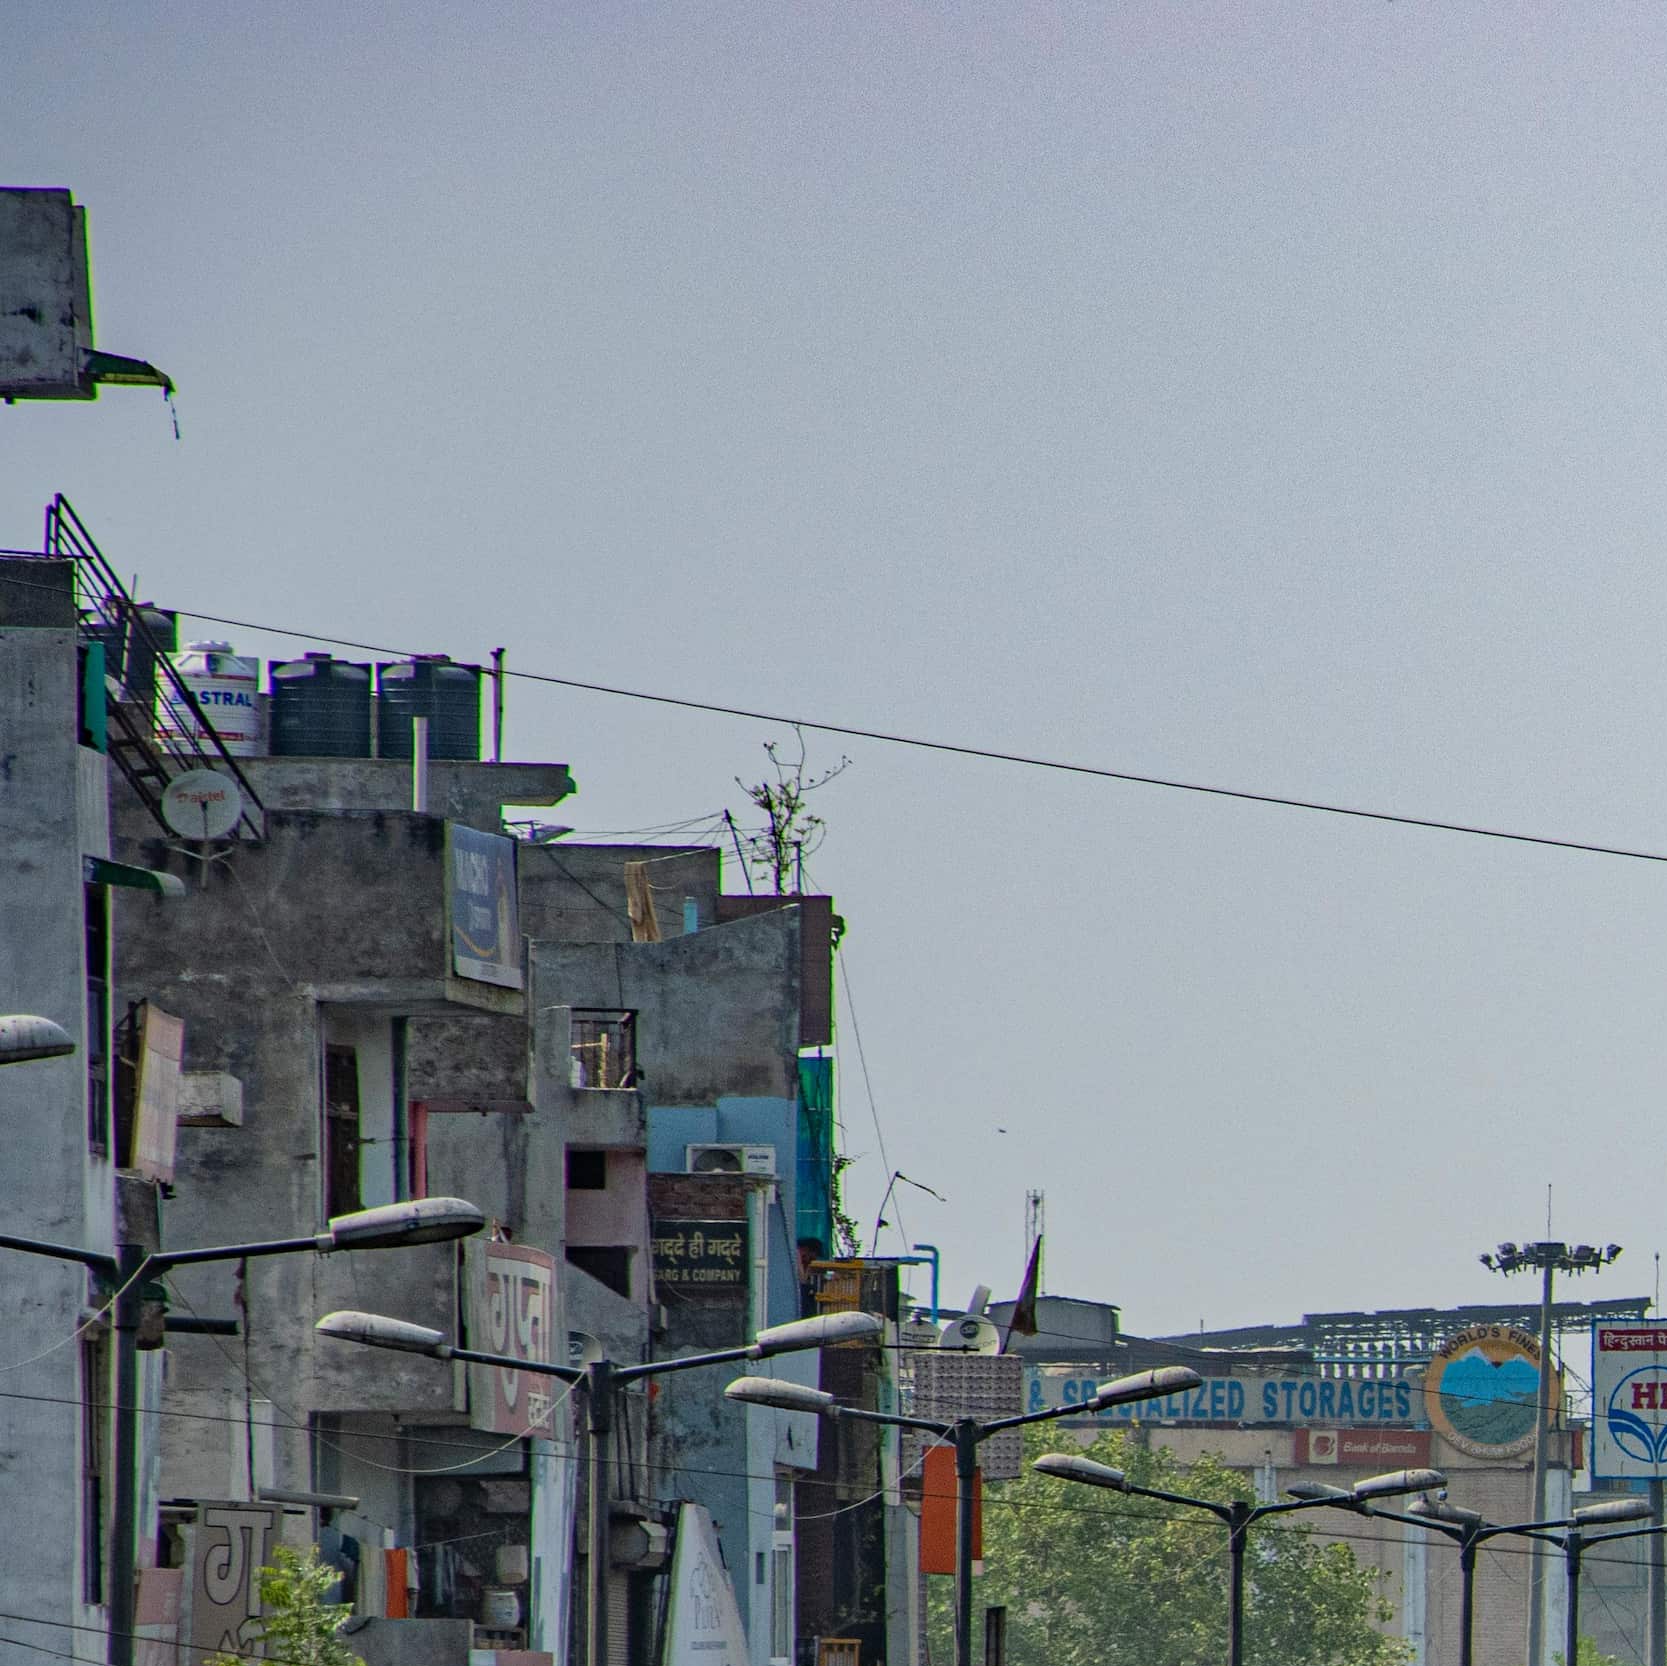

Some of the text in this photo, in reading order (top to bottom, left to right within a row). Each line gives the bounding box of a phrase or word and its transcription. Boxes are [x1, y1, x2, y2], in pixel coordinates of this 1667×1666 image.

[688, 1231, 705, 1259] ही
[707, 1232, 742, 1265] गद्दे
[682, 1269, 741, 1281] & COMPANY
[1440, 1325, 1501, 1360] WORLD'S
[1602, 1331, 1654, 1350] हिन्दुस्तान
[1029, 1380, 1043, 1411] &
[1263, 1380, 1411, 1419] STORAGES
